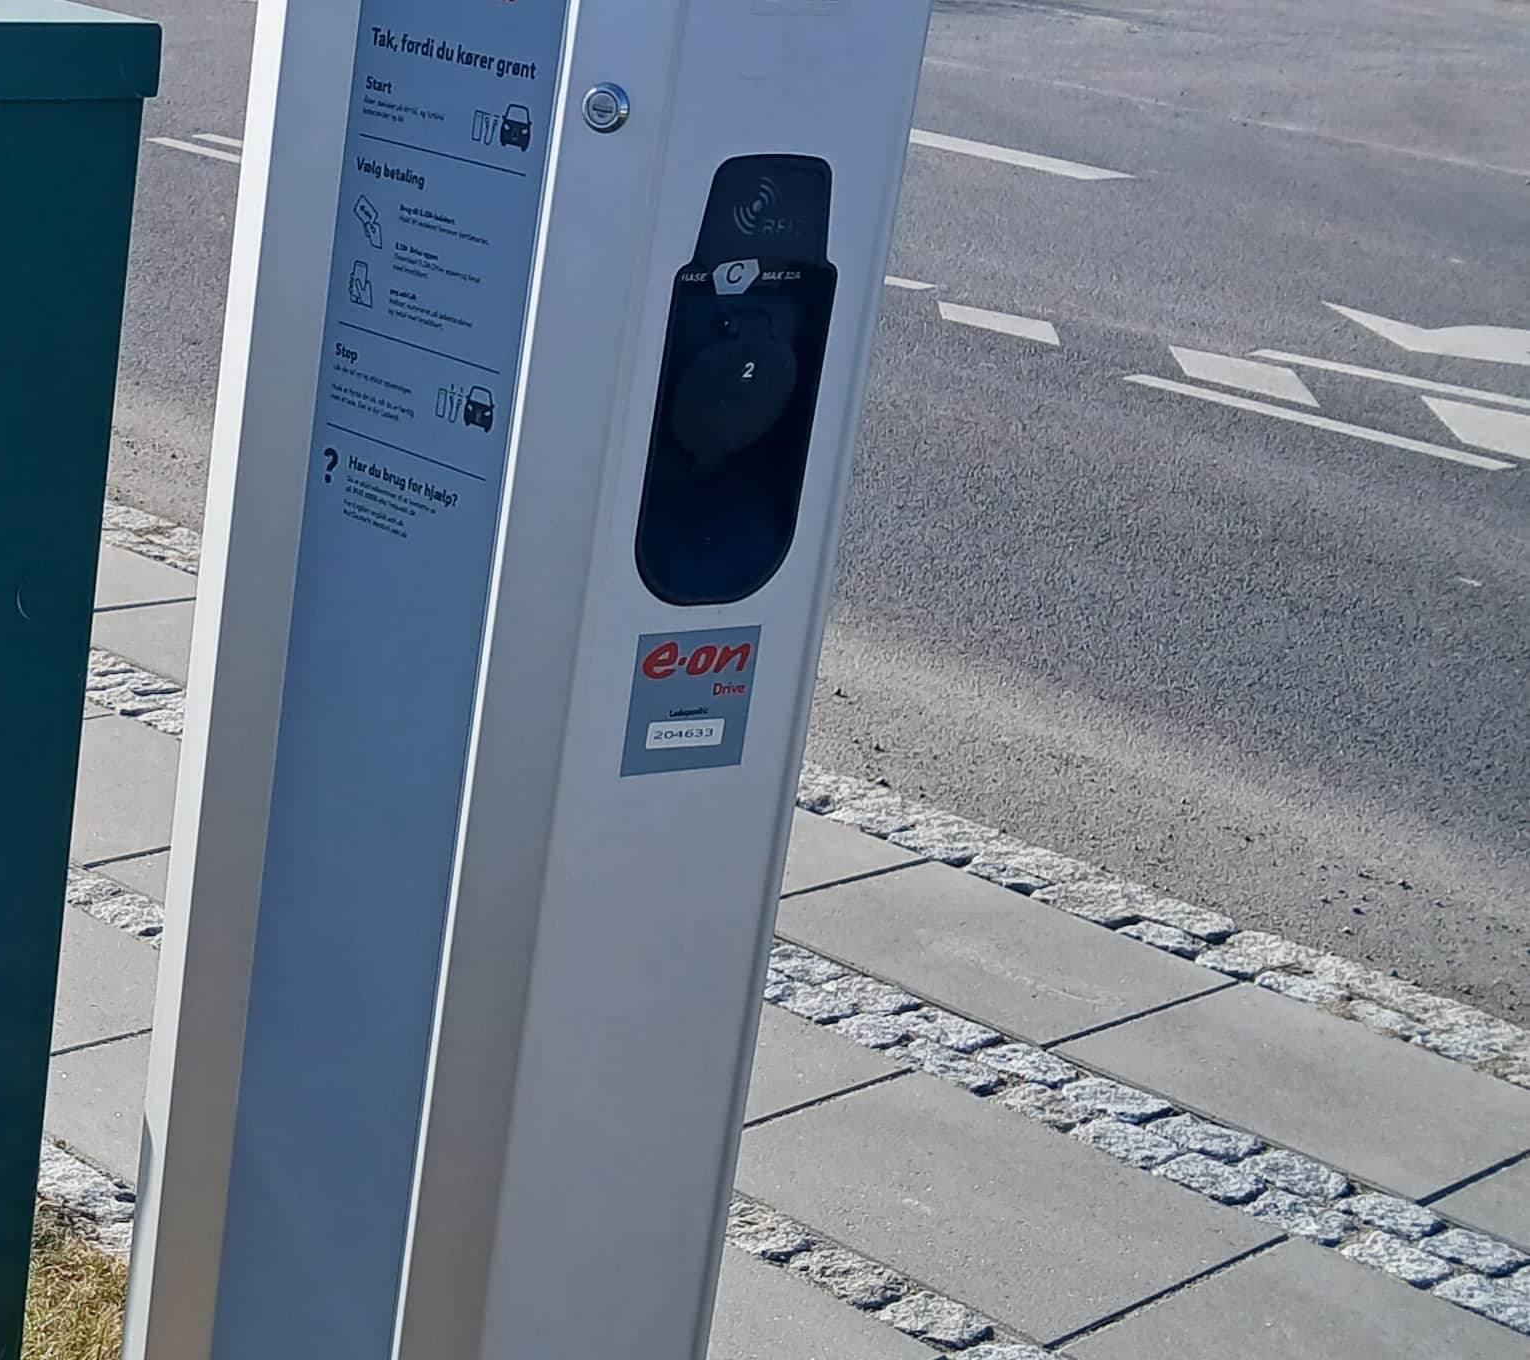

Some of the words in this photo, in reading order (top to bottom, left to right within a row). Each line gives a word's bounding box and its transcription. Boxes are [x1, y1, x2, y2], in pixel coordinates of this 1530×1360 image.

[372, 26, 399, 52] Tak,
[400, 32, 434, 60] fordi
[436, 41, 455, 64] du
[456, 43, 495, 71] kører
[496, 55, 537, 81] grønt
[366, 75, 393, 95] Start
[357, 156, 382, 180] Vælg
[383, 160, 425, 190] betaling
[335, 342, 358, 365] Stop
[741, 361, 756, 379] 2
[348, 455, 368, 474] Har
[368, 463, 381, 480] du
[382, 466, 406, 491] brug
[407, 477, 423, 495] for
[423, 483, 459, 508] hjælp?
[712, 682, 746, 697] Drive
[653, 726, 714, 741] 204633
